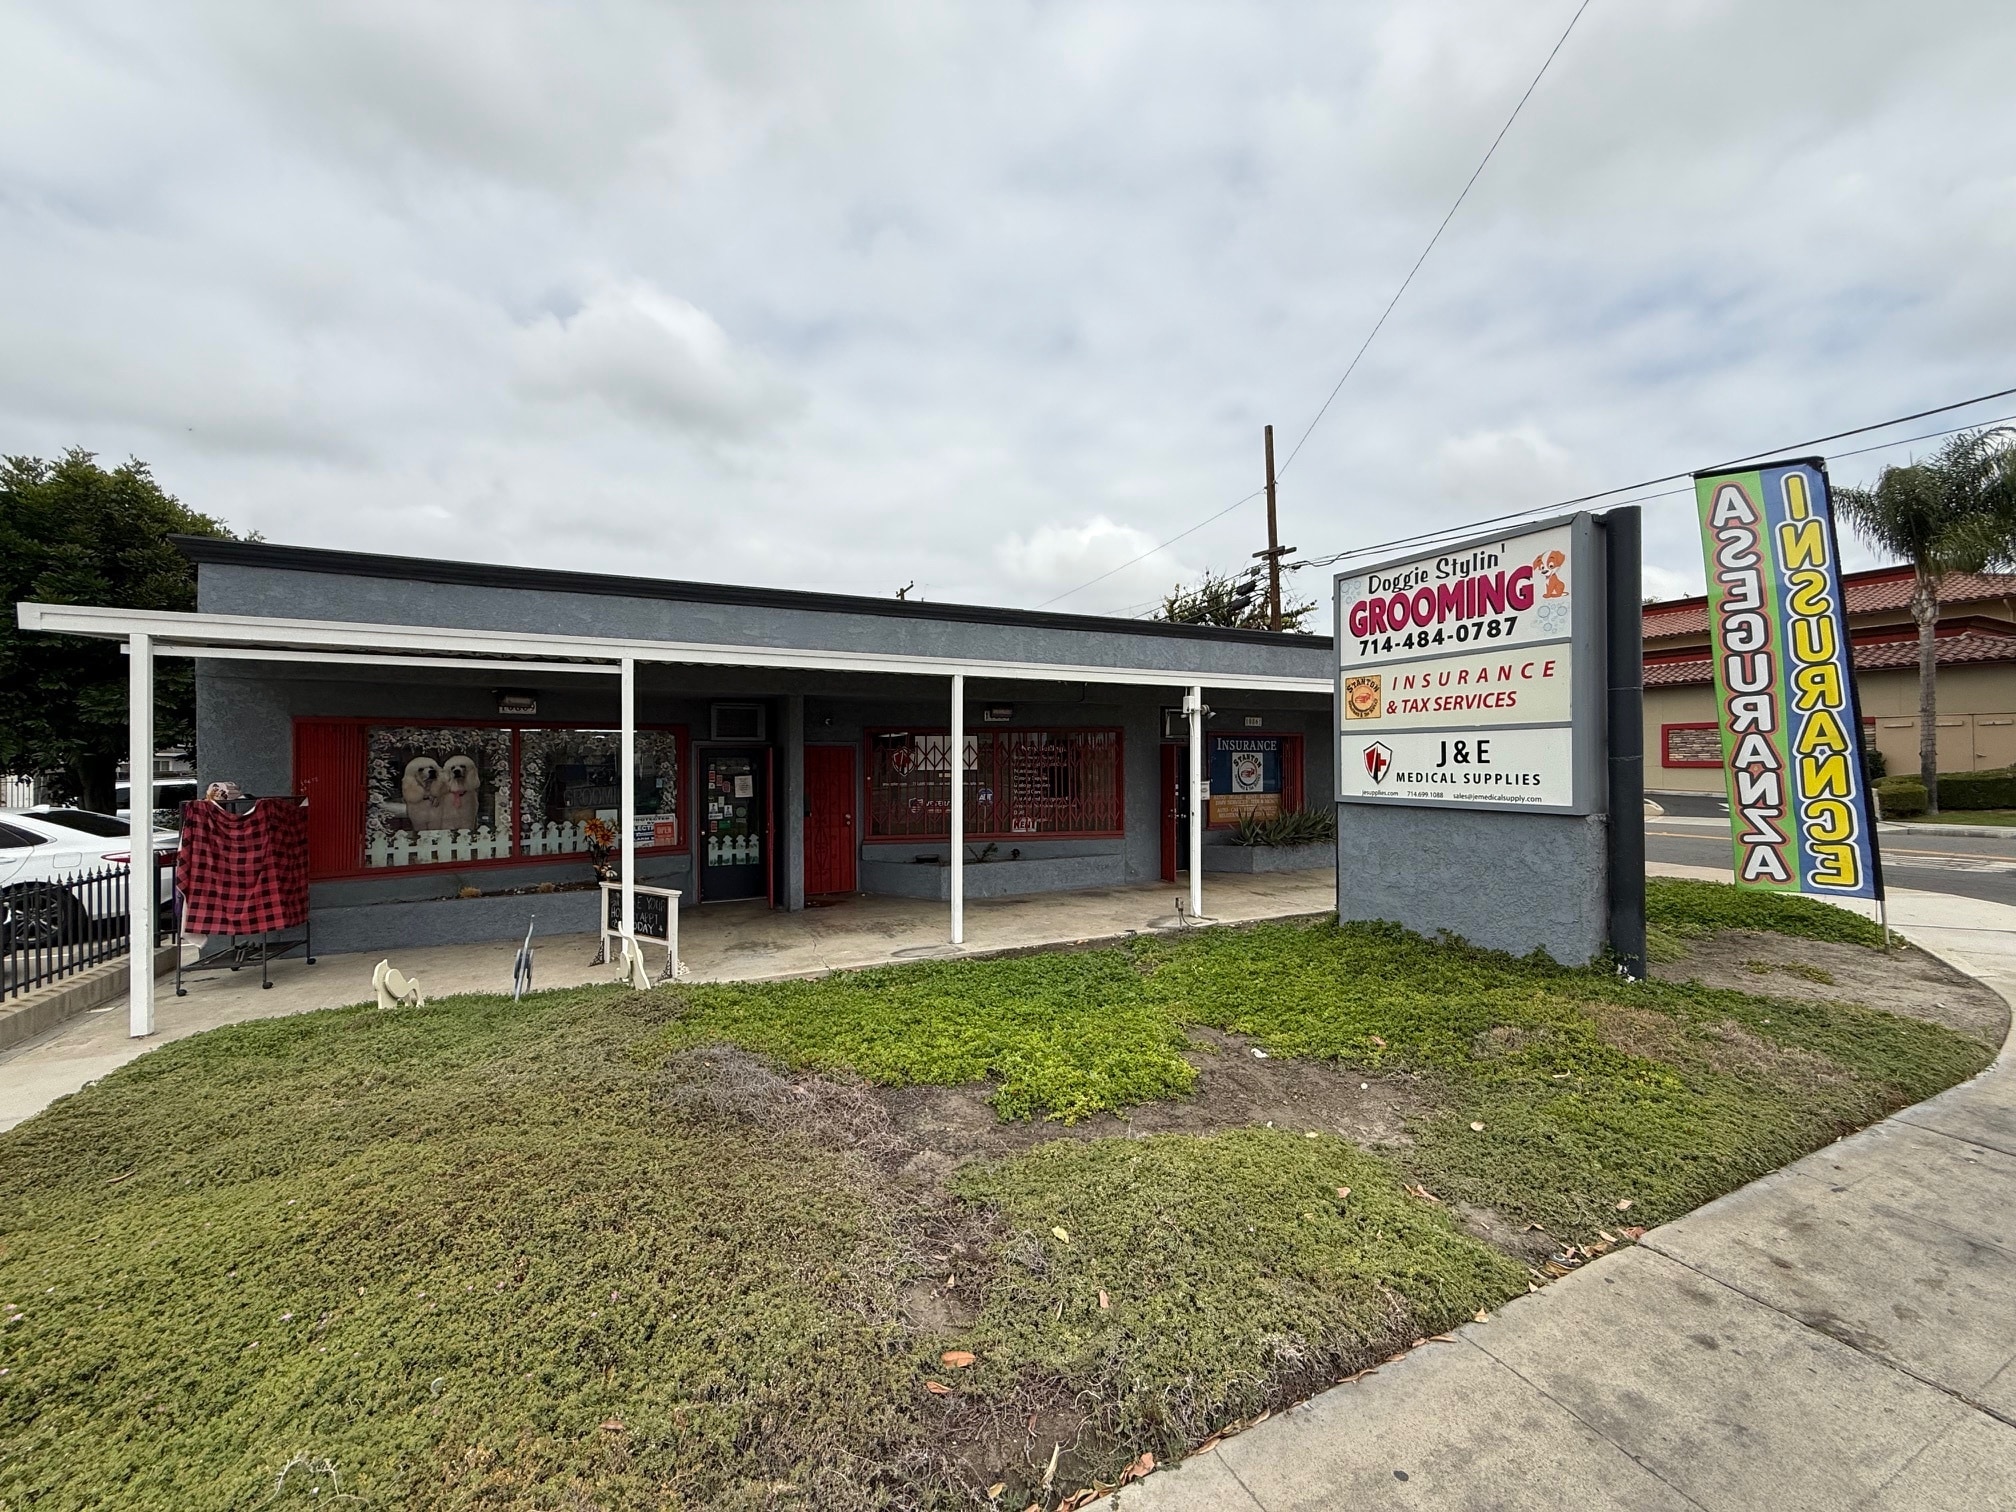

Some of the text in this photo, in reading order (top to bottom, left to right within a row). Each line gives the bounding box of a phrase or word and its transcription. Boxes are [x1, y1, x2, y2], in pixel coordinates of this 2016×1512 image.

[1368, 543, 1506, 594] Doggie Stylin'
[1349, 565, 1534, 638] GROOMING
[1359, 616, 1518, 656] 714-484-0787
[1392, 660, 1556, 691] INSURANCE
[1346, 678, 1380, 693] STANTON
[1386, 700, 1398, 714] &
[1401, 697, 1430, 713] TAX
[1433, 691, 1517, 711] SERVICES
[1216, 737, 1277, 751] INSURANCE
[1233, 754, 1262, 768] STANTON
[1396, 772, 1541, 786] MEDICAL SUPPLIES
[1453, 793, 1543, 803] sales@jemedicalsupply.com
